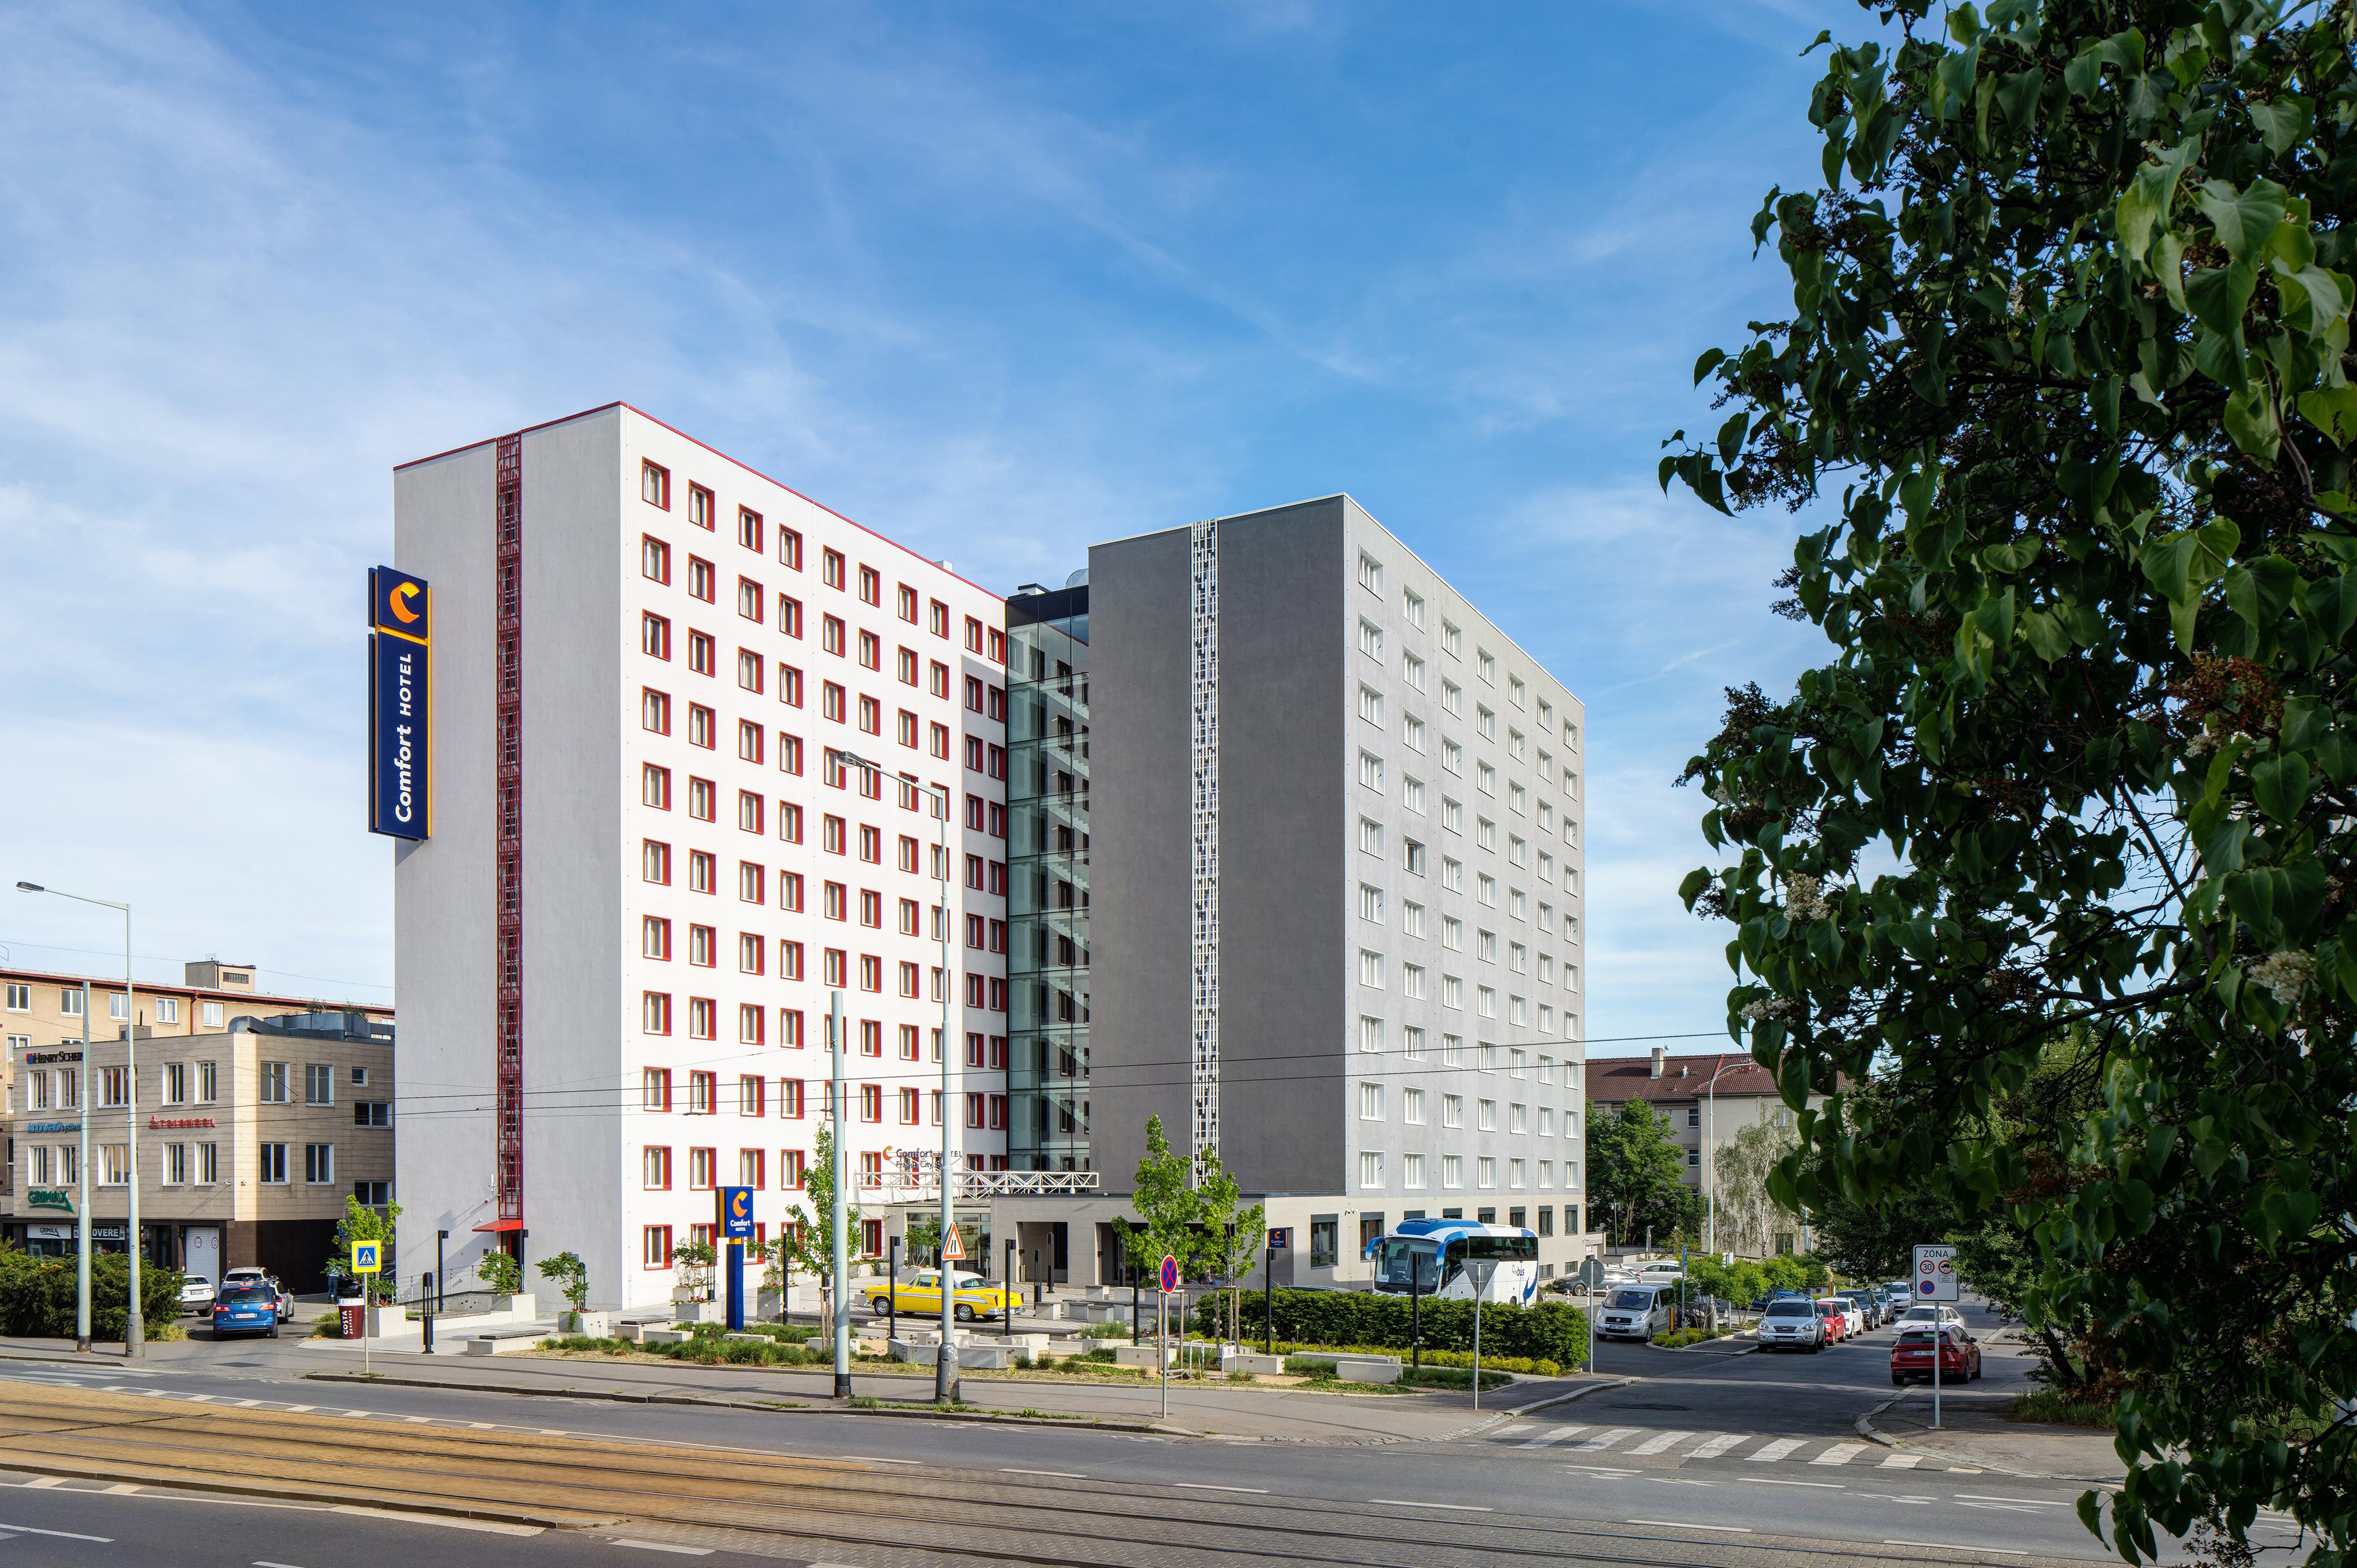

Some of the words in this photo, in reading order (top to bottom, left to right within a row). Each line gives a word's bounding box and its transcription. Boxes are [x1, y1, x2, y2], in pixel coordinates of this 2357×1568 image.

[399, 653, 412, 717] HOTEL
[394, 725, 412, 823] Comfort
[896, 1148, 933, 1158] Comfort
[896, 1161, 919, 1170] Prague
[920, 1161, 933, 1170] City
[28, 1190, 74, 1212] GRIMAX
[39, 1227, 60, 1236] GRIMAX
[92, 1227, 118, 1237] DVEŘE
[1923, 1248, 1949, 1257] ZÓNA
